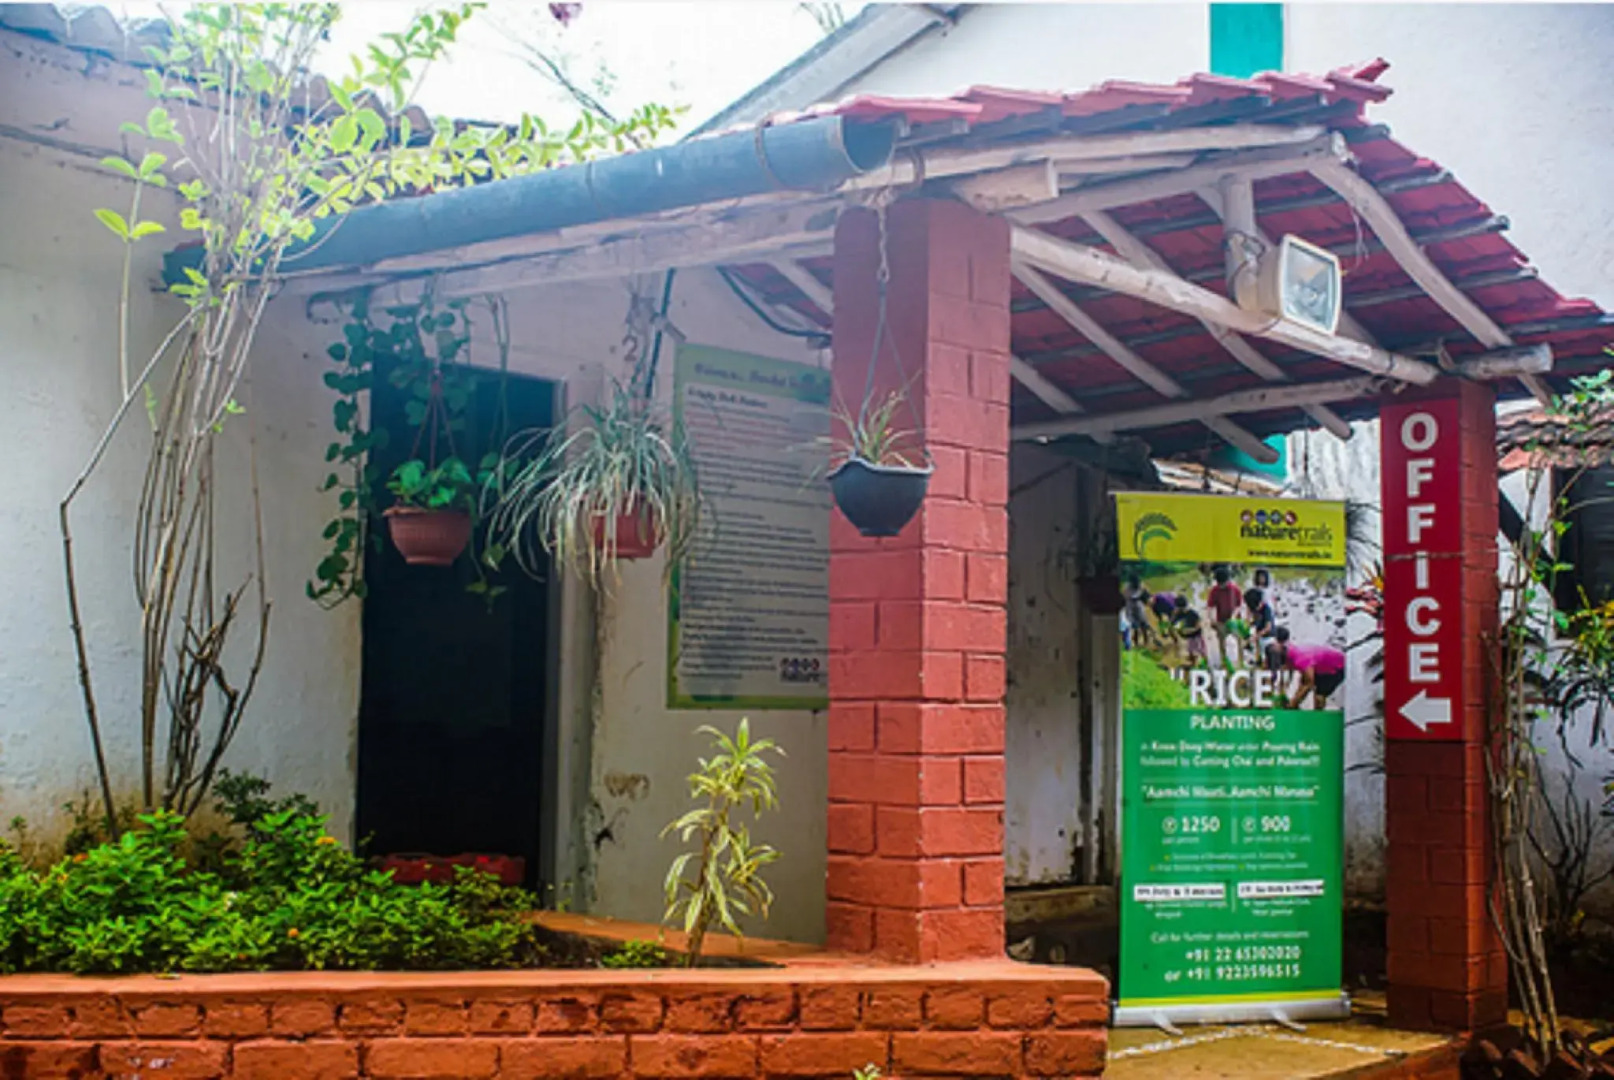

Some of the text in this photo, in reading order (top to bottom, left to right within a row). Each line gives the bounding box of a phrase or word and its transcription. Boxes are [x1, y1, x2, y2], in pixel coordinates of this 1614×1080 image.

[1400, 411, 1442, 683] OFFICE
[1189, 715, 1276, 730] PLANTING
[1298, 741, 1320, 751] Rain
[1231, 755, 1253, 766] Chai
[1256, 755, 1275, 766] and
[1181, 815, 1221, 832] 1250
[1260, 815, 1291, 832] 900
[1185, 948, 1210, 962] +91
[1215, 946, 1232, 961] 22
[1163, 970, 1182, 982] or
[1186, 966, 1211, 980] +91
